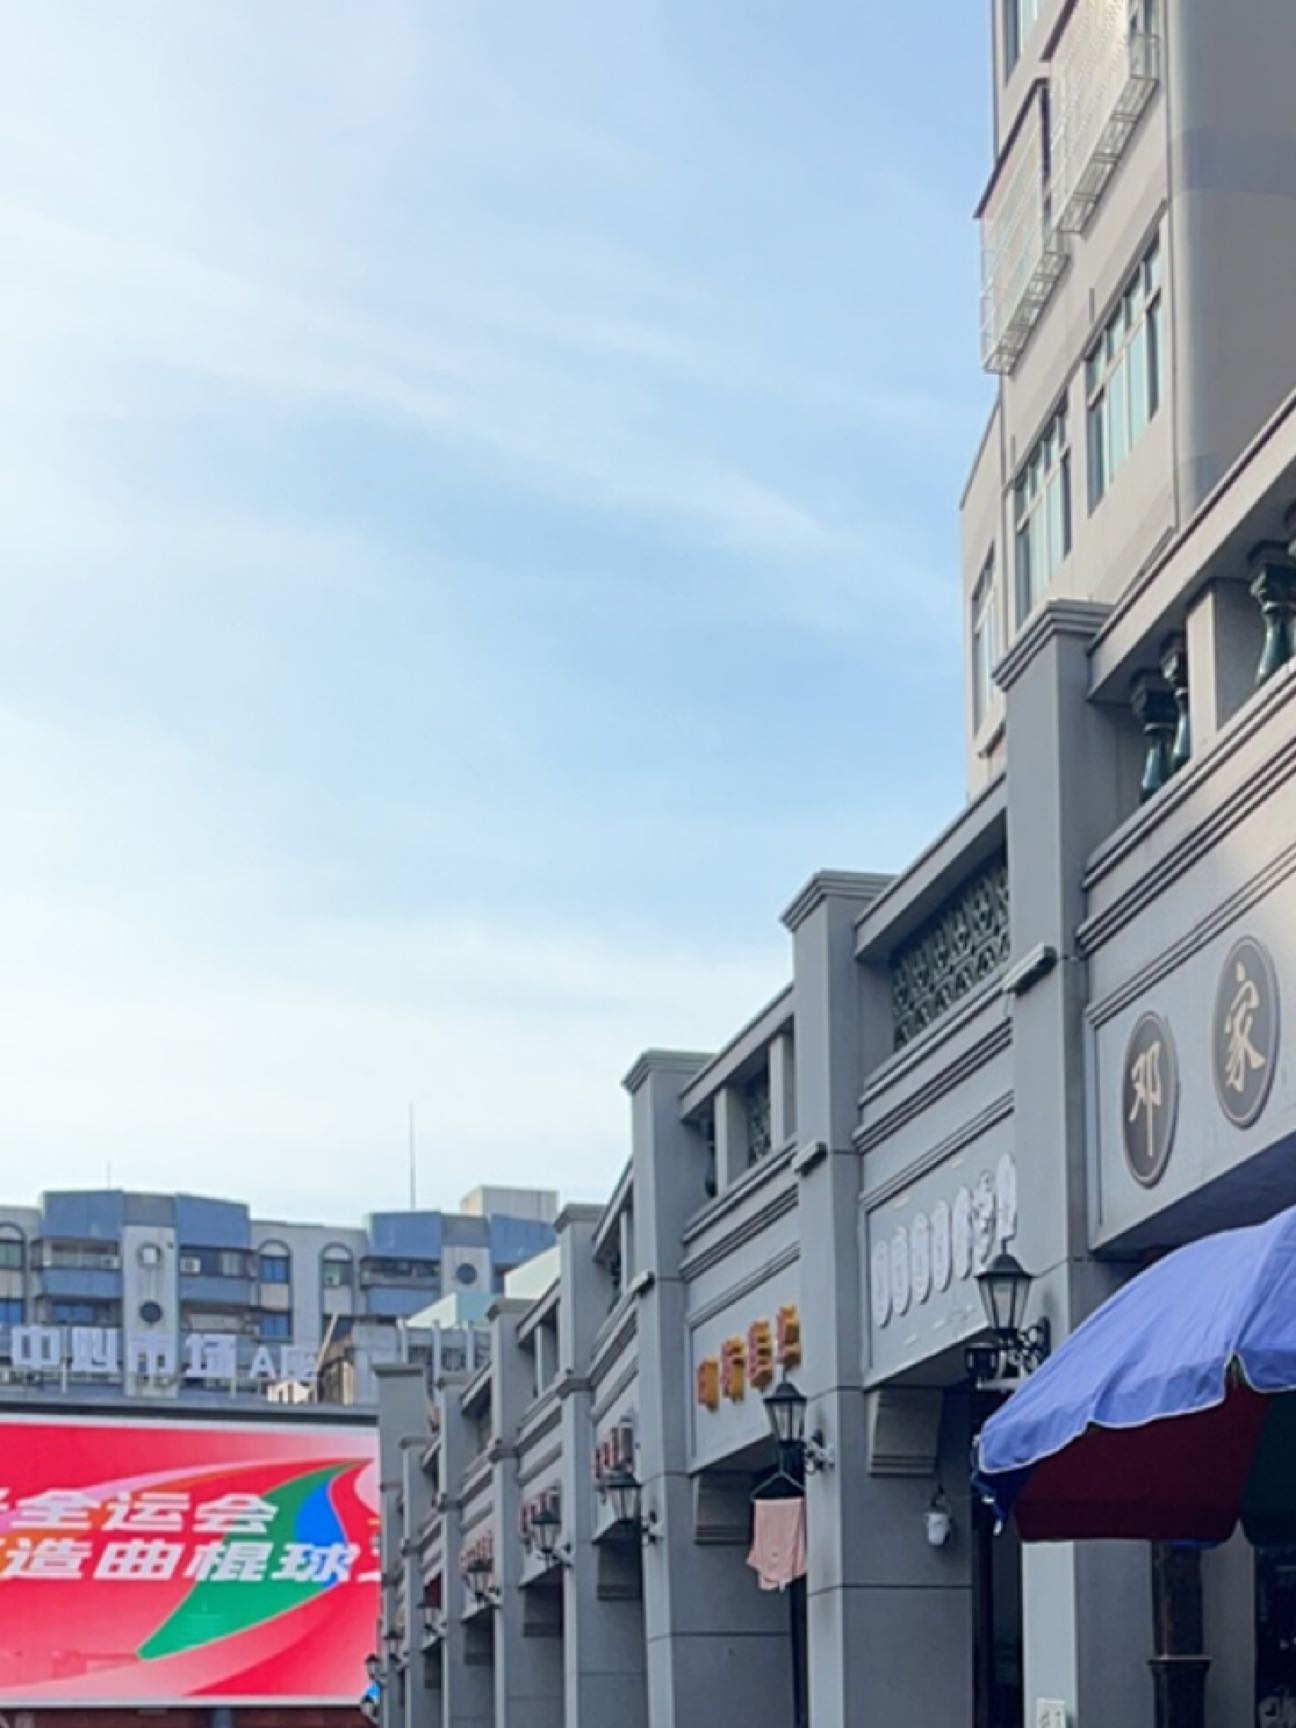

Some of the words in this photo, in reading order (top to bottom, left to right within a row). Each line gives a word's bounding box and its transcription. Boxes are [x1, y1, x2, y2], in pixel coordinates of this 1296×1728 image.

[0, 1487, 278, 1534] 全运会
[0, 1538, 380, 1582] 造曲棍球
